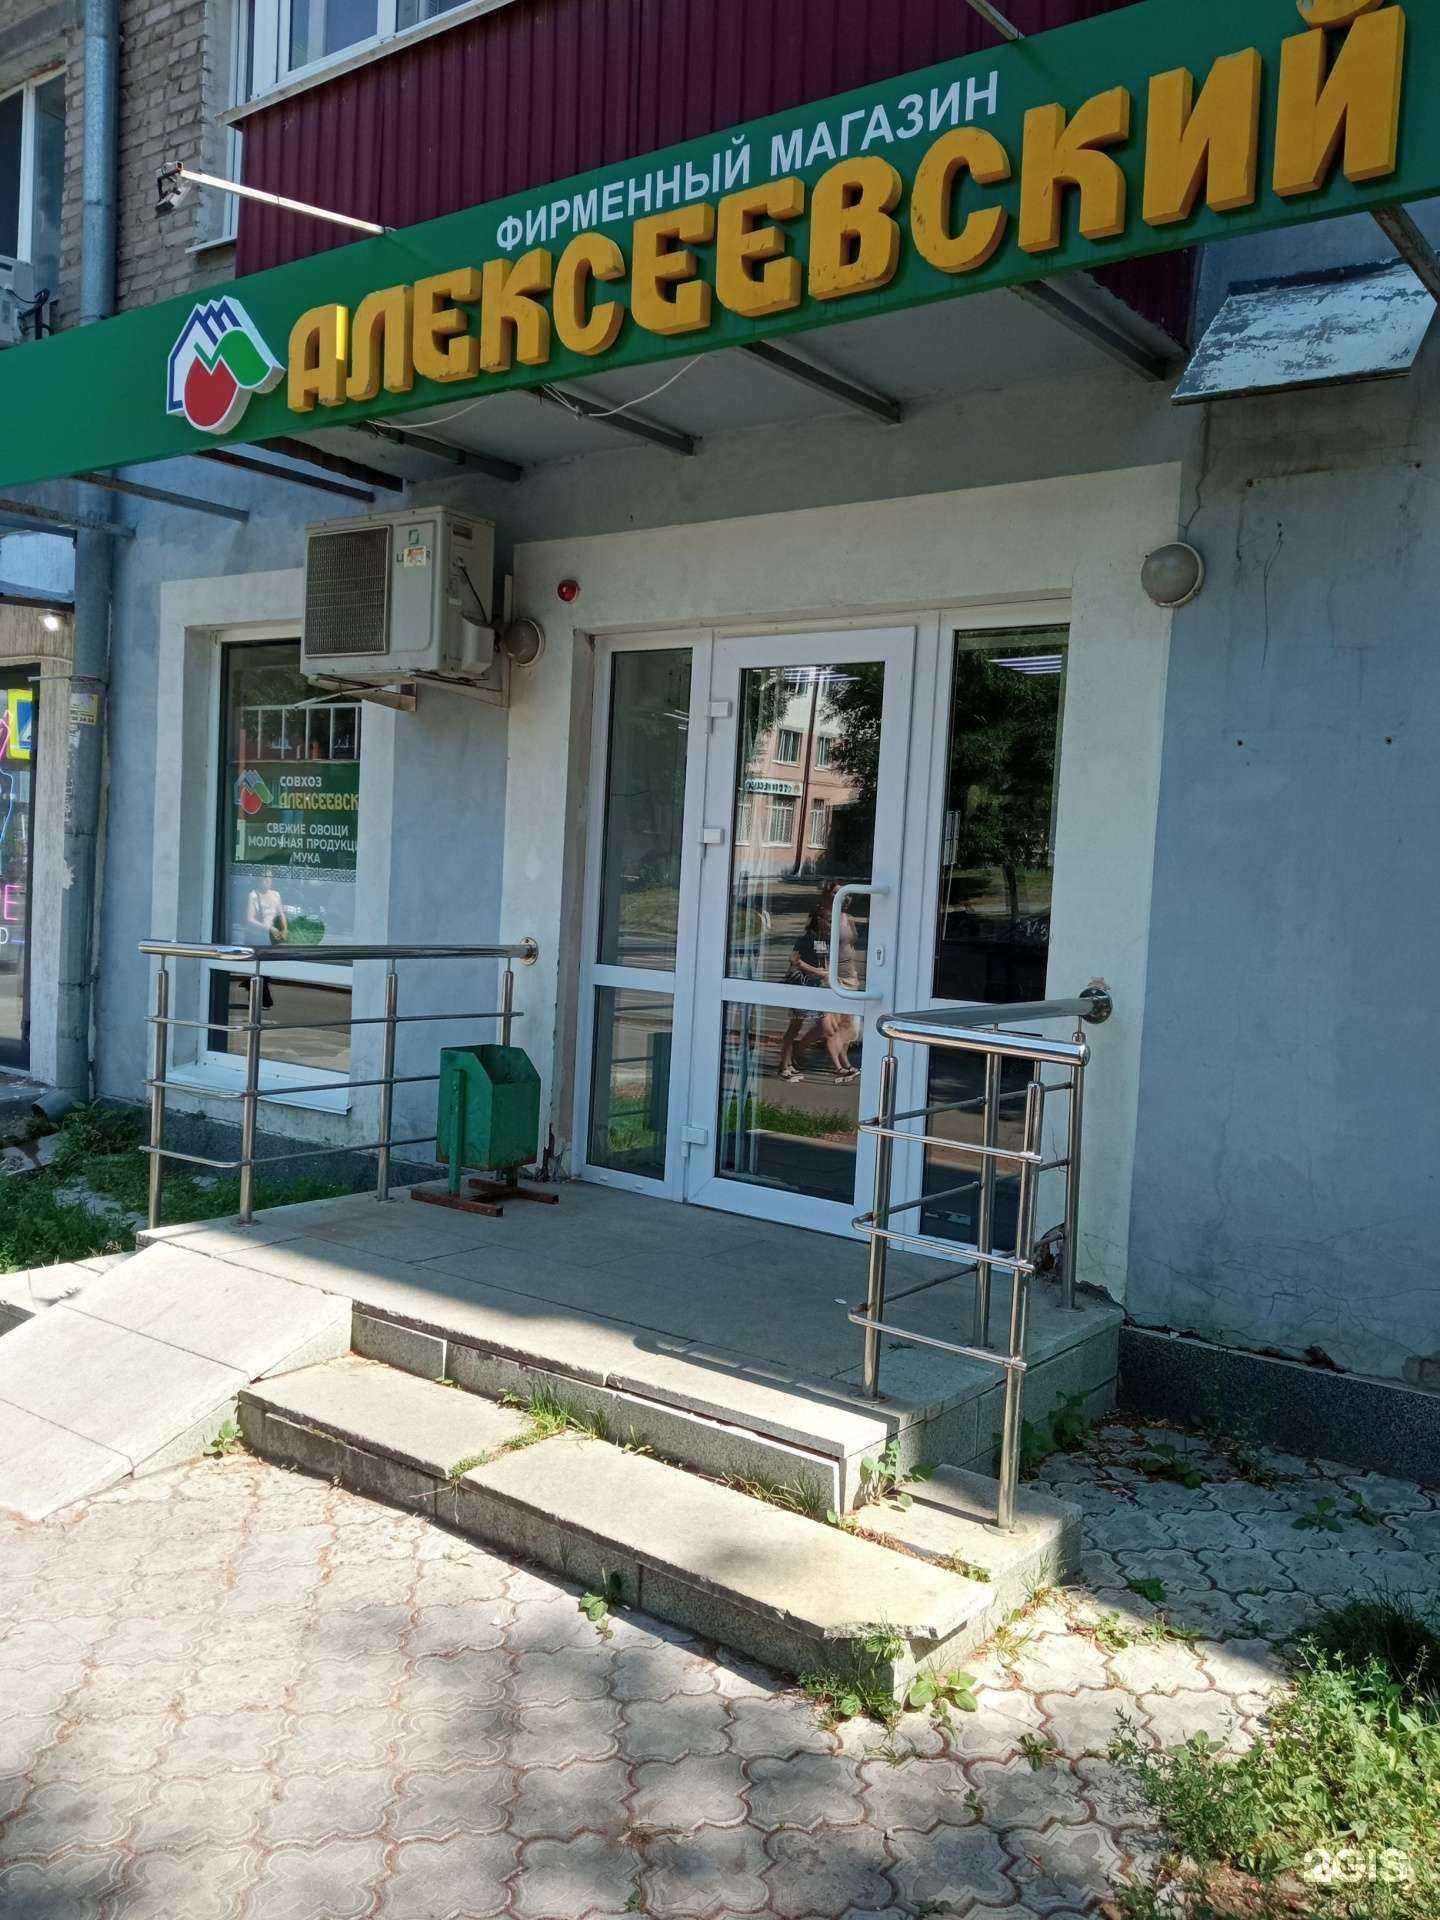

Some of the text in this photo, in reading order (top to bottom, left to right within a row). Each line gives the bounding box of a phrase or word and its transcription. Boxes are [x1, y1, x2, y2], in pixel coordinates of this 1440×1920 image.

[496, 70, 999, 251] ФИРМЕННЫЙ МАГАЗИН
[287, 0, 1406, 413] АЛЕКСЕЕВСКИЙ
[279, 776, 322, 788] СОВХОЗ
[266, 822, 349, 838] СВЕЖИЕ ОВОЩИ
[248, 835, 303, 849] МОЛОЧНАЯ
[291, 851, 321, 864] МУКА
